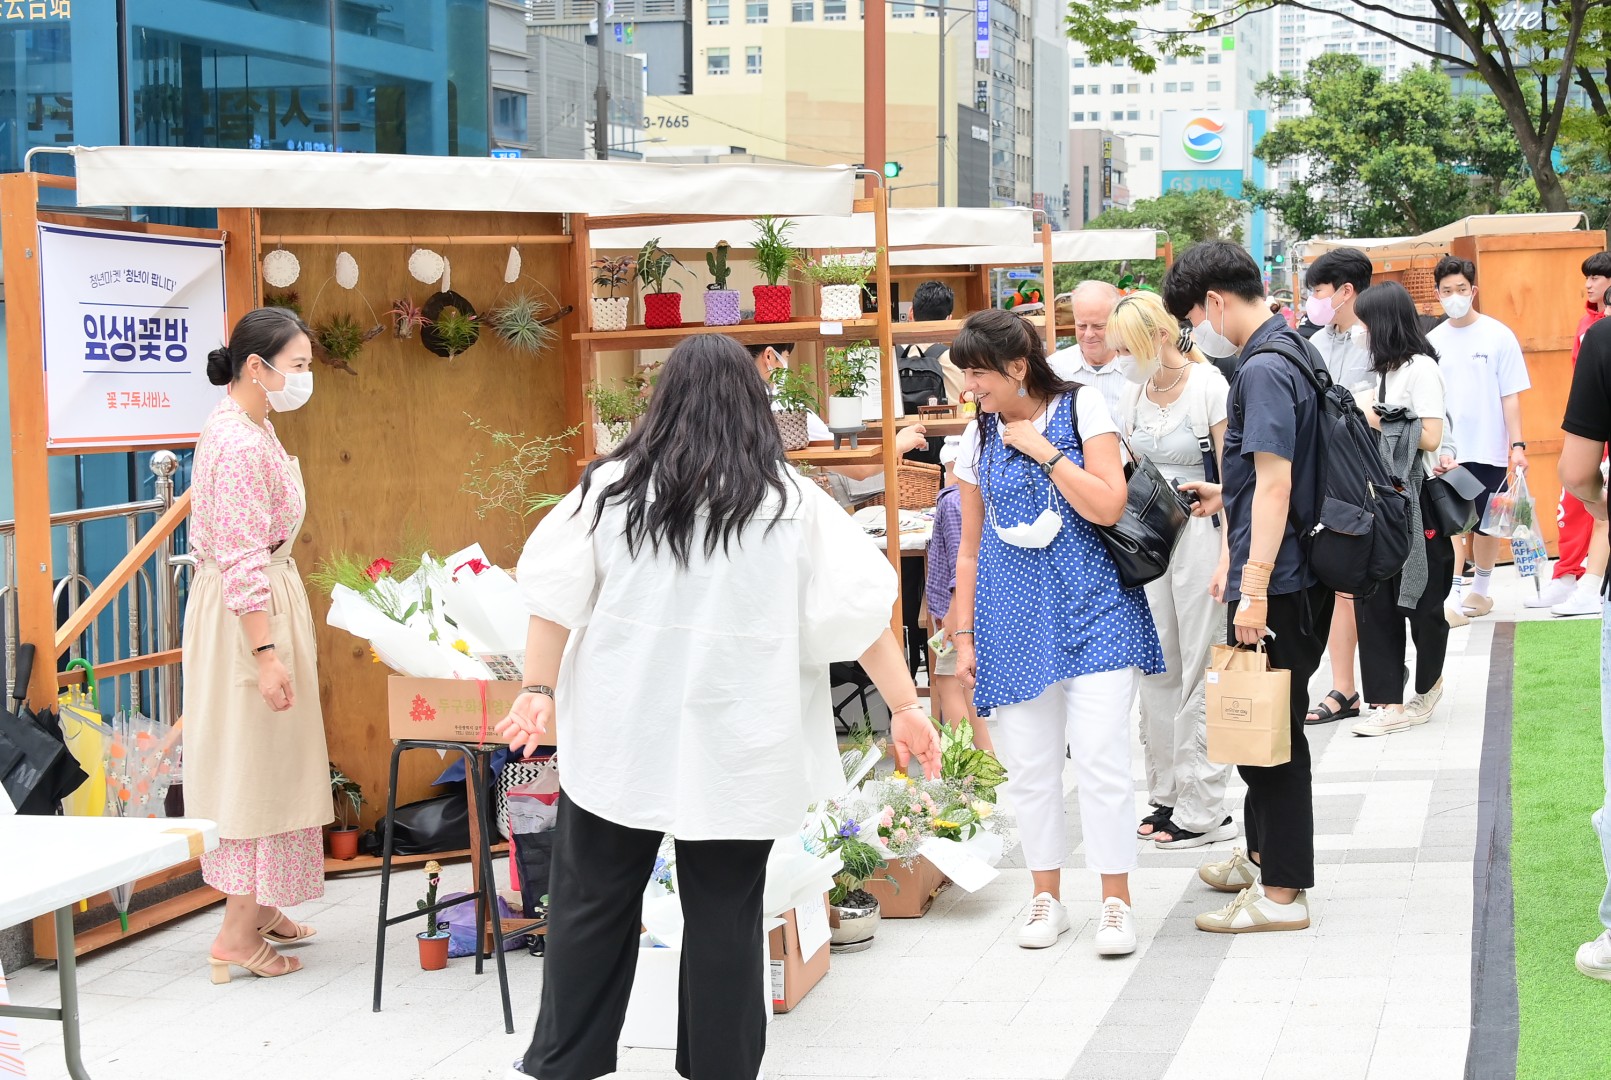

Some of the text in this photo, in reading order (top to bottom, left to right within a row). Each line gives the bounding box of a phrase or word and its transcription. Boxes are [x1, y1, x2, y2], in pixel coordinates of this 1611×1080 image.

[0, 0, 70, 19] 云台站
[1170, 177, 1193, 192] GS
[89, 269, 121, 289] 청년마켓
[83, 314, 189, 363] 잎생꽃방
[106, 391, 171, 409] 꽃 구독서비스
